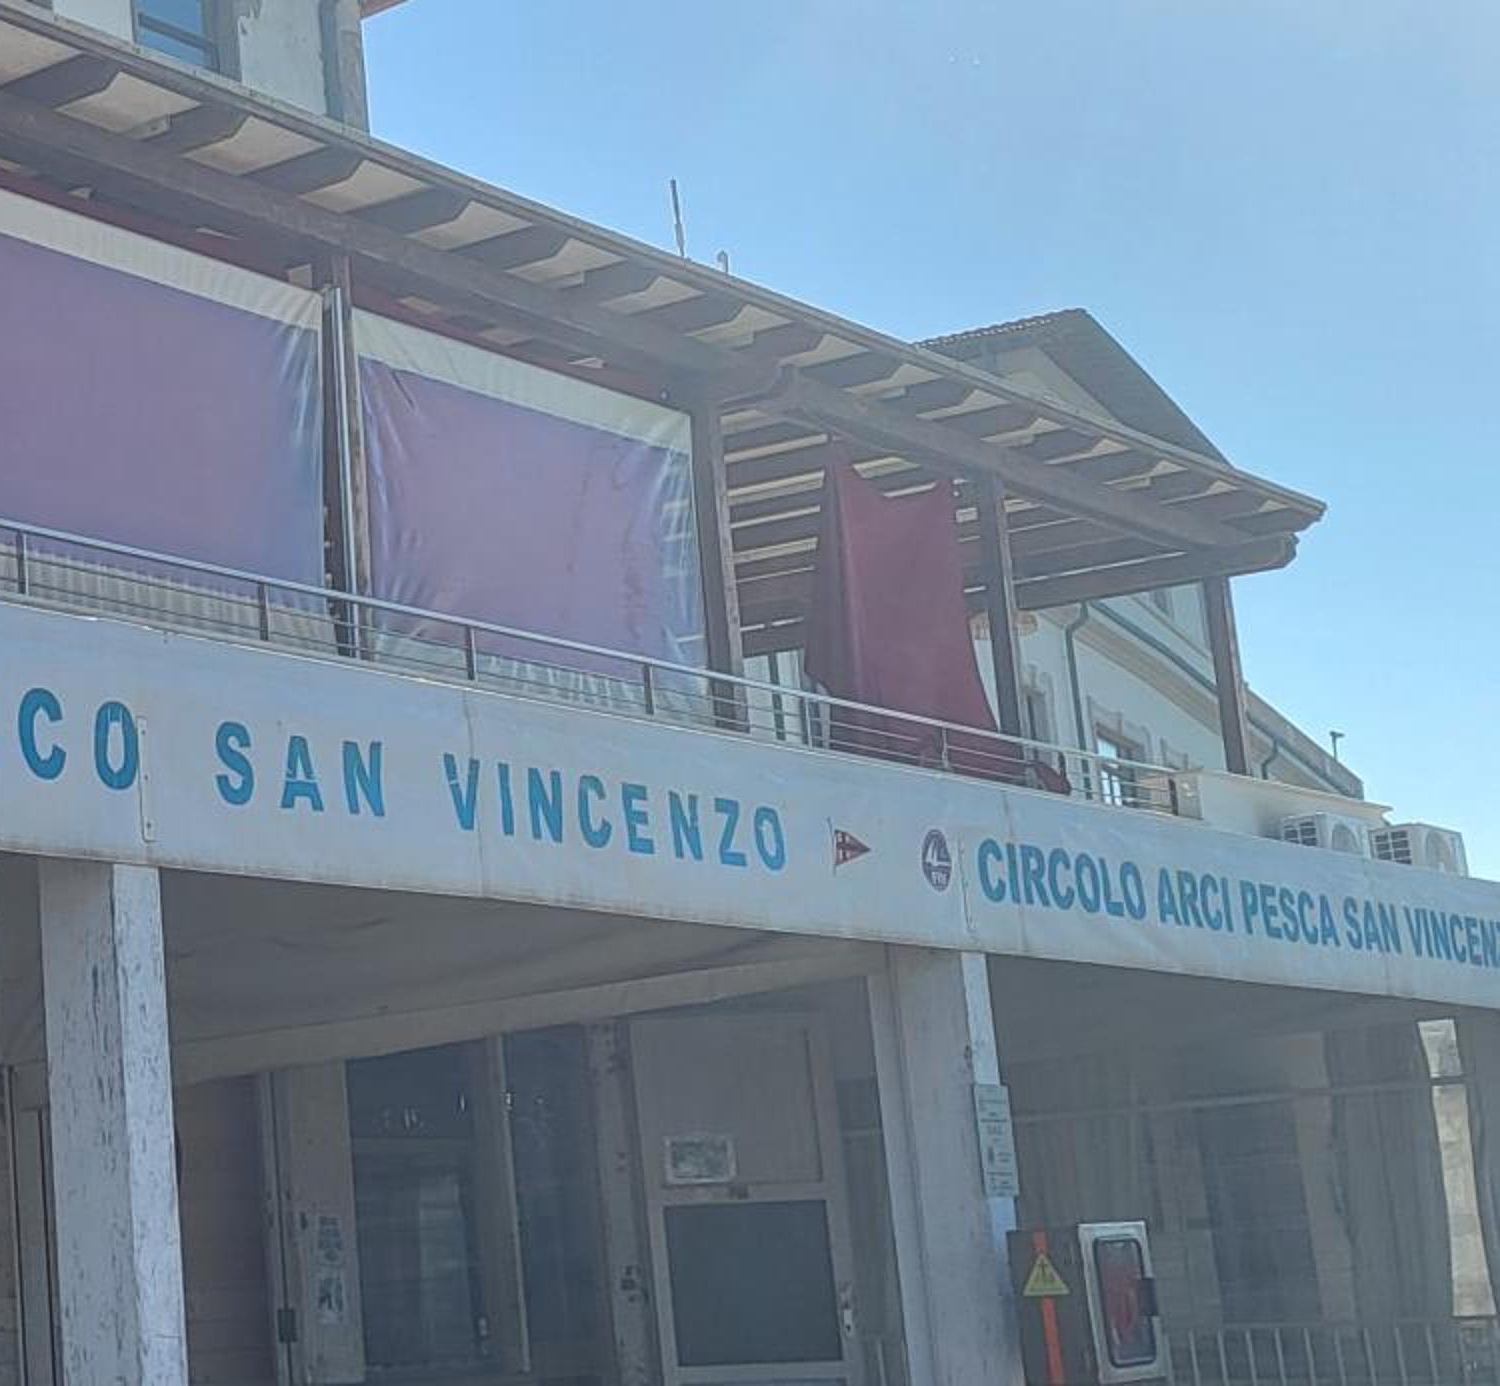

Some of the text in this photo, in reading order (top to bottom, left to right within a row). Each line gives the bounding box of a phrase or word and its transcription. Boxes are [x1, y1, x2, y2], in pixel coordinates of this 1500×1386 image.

[215, 721, 386, 817] SAN
[443, 753, 788, 872] VINCENZO
[977, 837, 1500, 970] CIRCOLO ARCI PESCA SAN VINCEN
